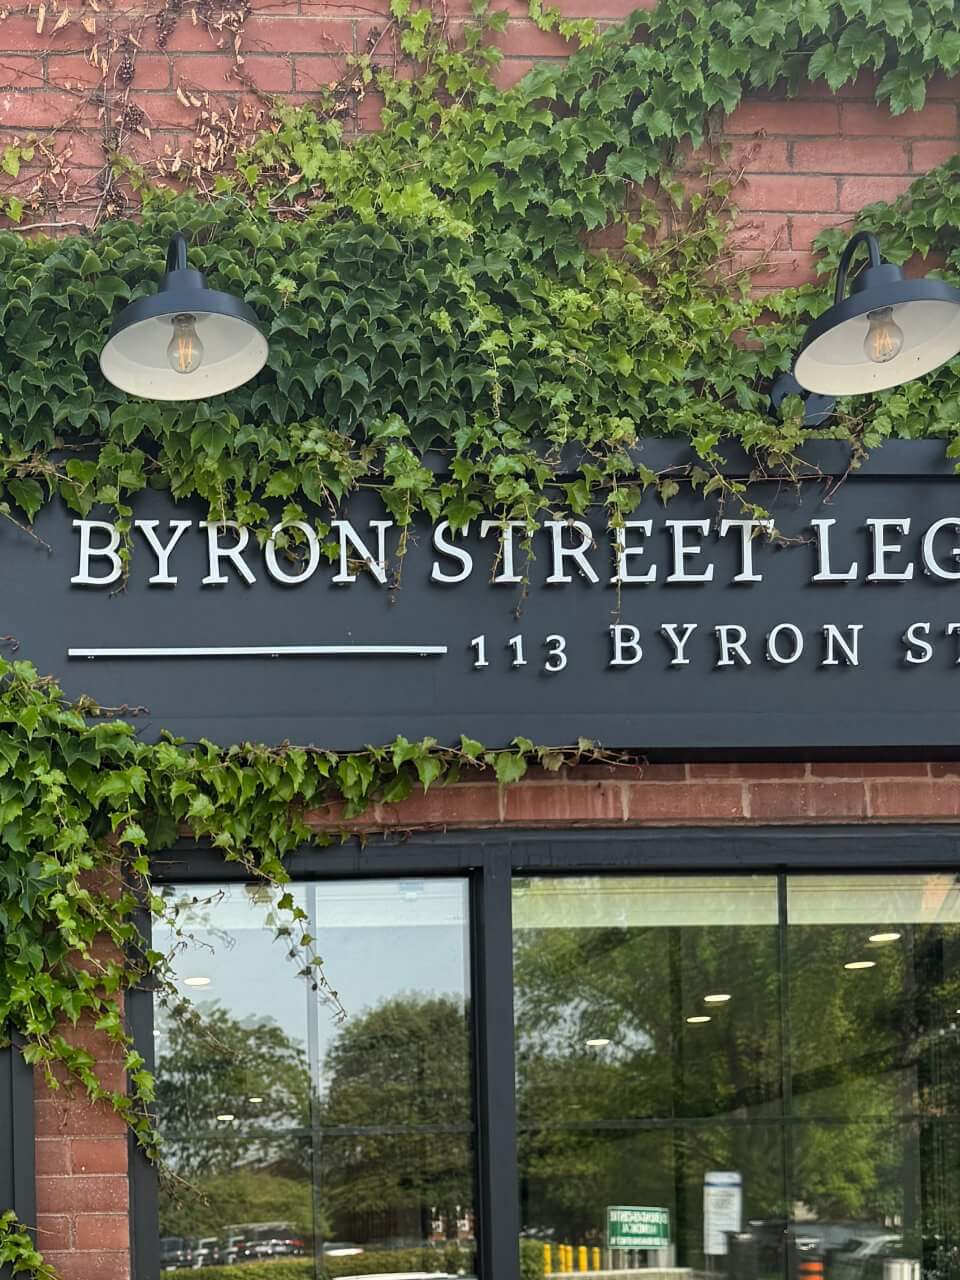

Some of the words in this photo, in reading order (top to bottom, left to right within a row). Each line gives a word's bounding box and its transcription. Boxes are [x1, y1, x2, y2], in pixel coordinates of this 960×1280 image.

[70, 518, 393, 585] BYRON
[431, 518, 775, 584] STREET
[471, 634, 568, 672] 113
[609, 623, 863, 667] BYRON
